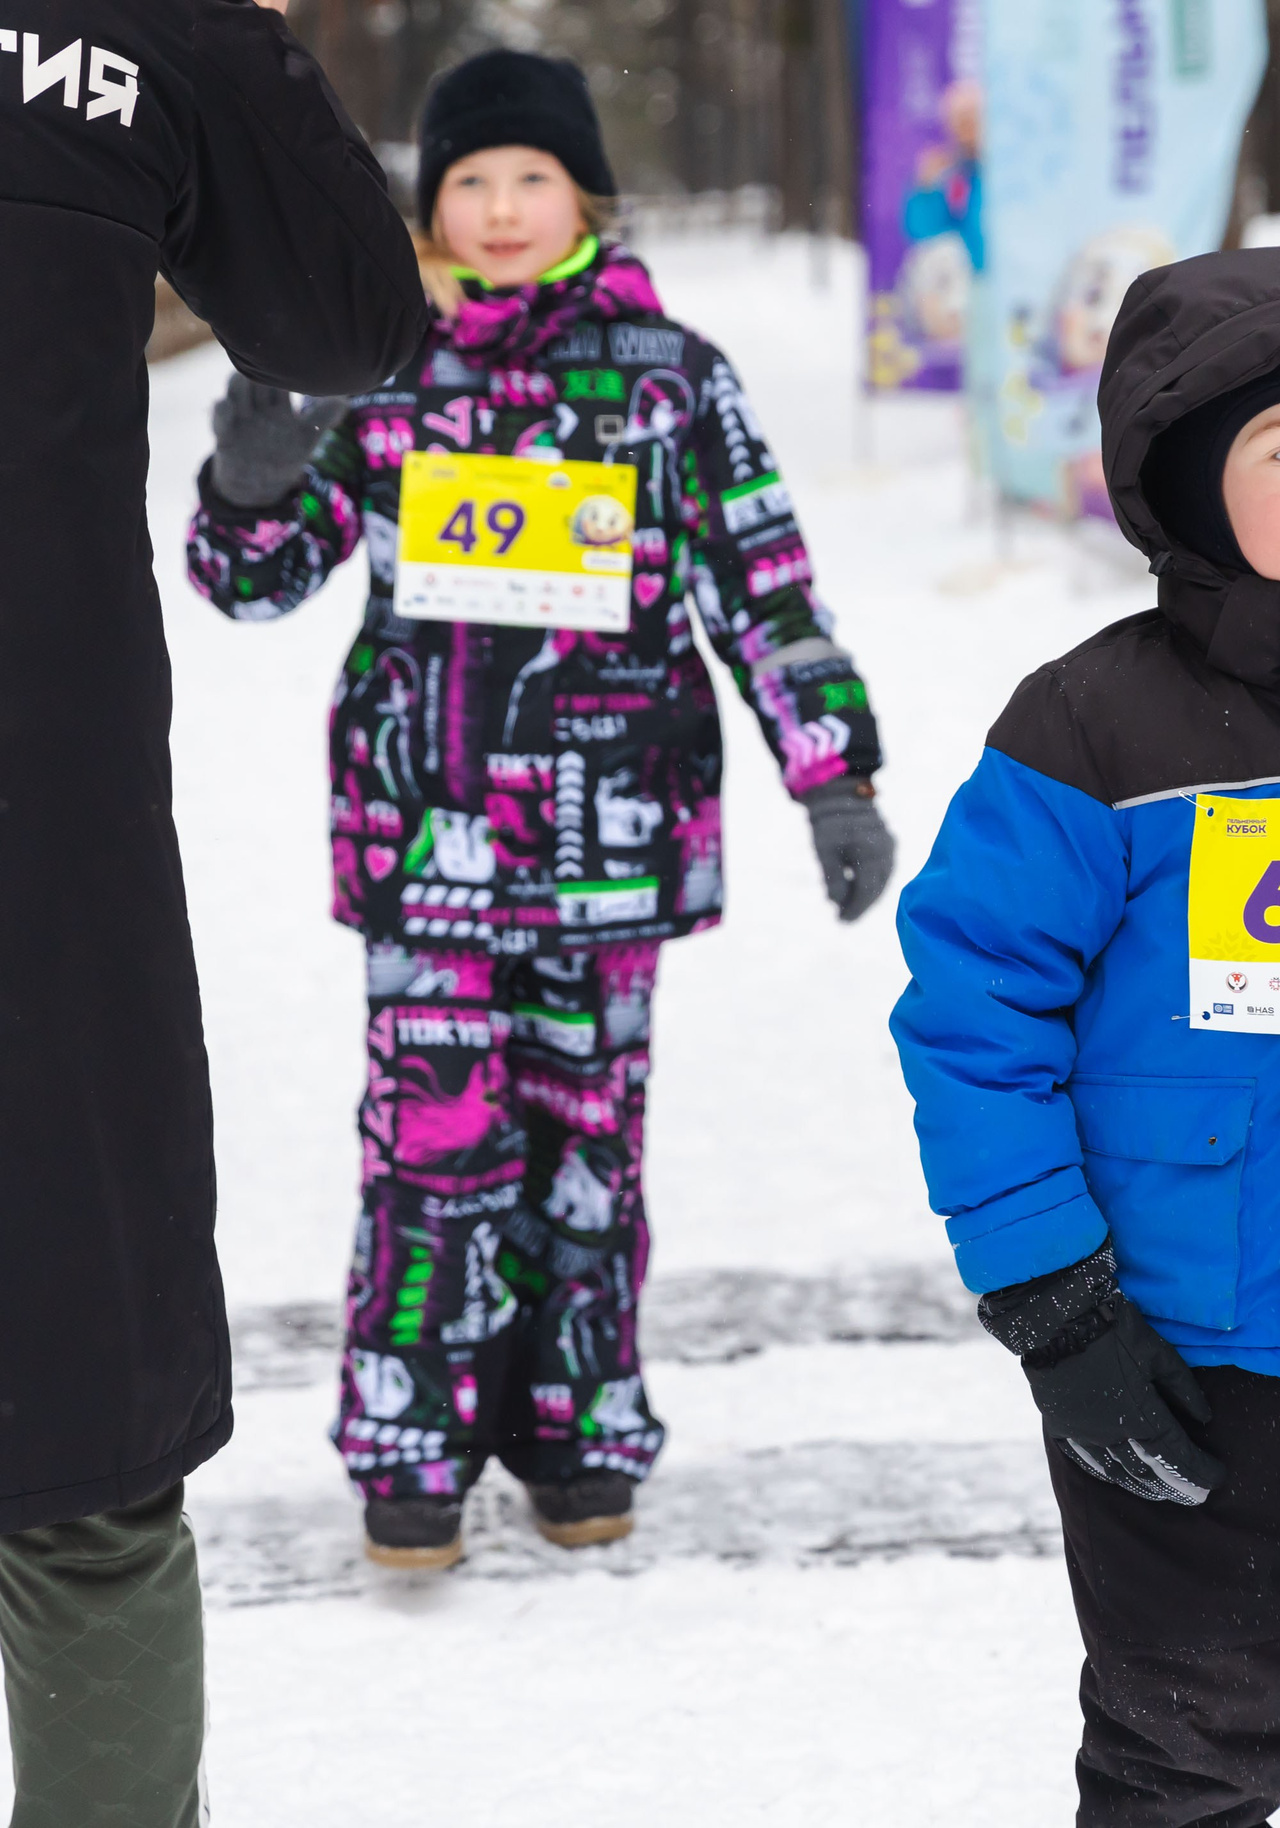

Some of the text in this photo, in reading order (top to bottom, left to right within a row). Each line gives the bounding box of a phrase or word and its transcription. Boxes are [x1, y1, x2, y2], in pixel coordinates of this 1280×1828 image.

[438, 499, 525, 555] 49
[1226, 824, 1267, 834] КУБОК
[1255, 1006, 1275, 1014] HAS
